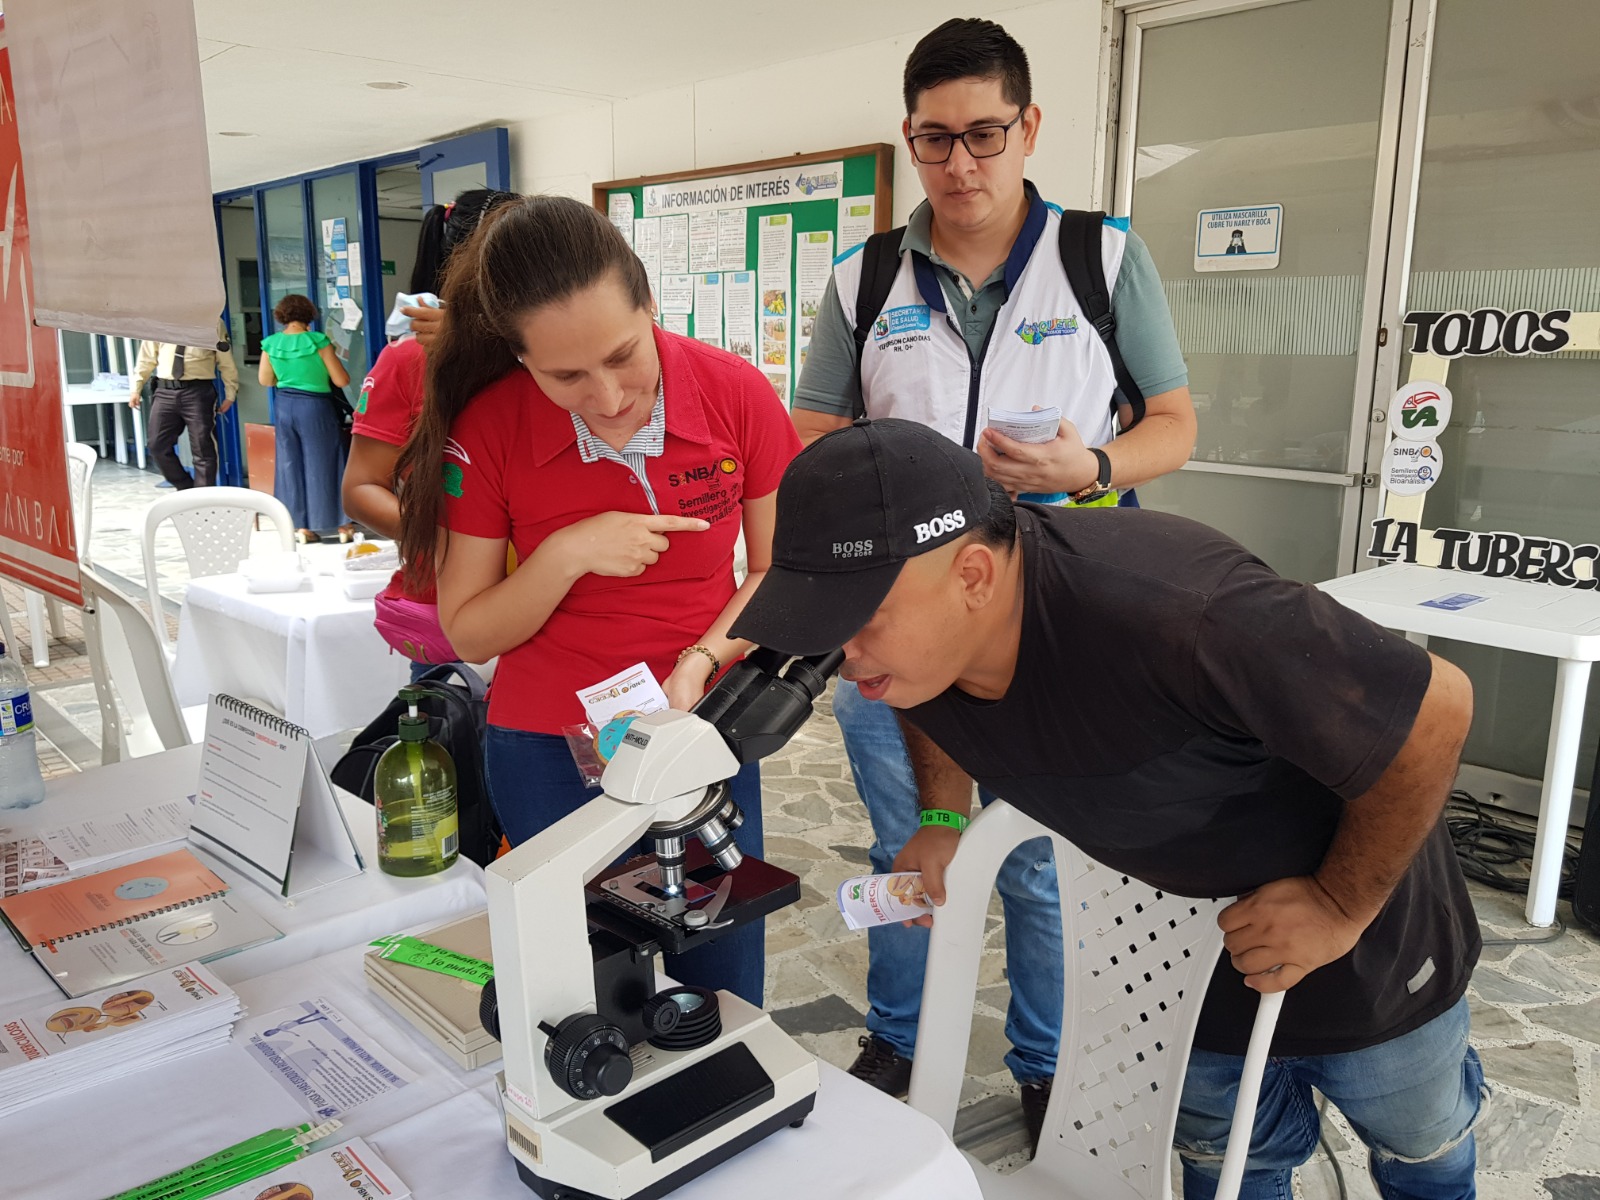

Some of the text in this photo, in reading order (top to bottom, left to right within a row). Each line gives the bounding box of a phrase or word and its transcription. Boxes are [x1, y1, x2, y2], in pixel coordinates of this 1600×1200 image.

[662, 176, 790, 209] INFORMACIÓN DE INTERÉS
[1207, 220, 1224, 229] CUBRE
[1234, 219, 1250, 227] NARIZ
[1256, 218, 1271, 226] BOCA
[1212, 210, 1268, 221] UTILIZA MASCARILLA
[900, 316, 919, 324] SALUD
[1403, 308, 1571, 355] TODOS
[678, 489, 727, 510] Semillero
[913, 509, 966, 544] BOSS
[832, 540, 874, 554] BOSS
[1368, 518, 1418, 564] LA
[625, 732, 649, 746] ANTI-MOLD
[925, 812, 950, 822] la TB
[427, 957, 444, 966] Yo
[444, 963, 478, 976] puedo
[4, 1022, 41, 1060] TUBERCULOSIS
[581, 1050, 589, 1058] 20
